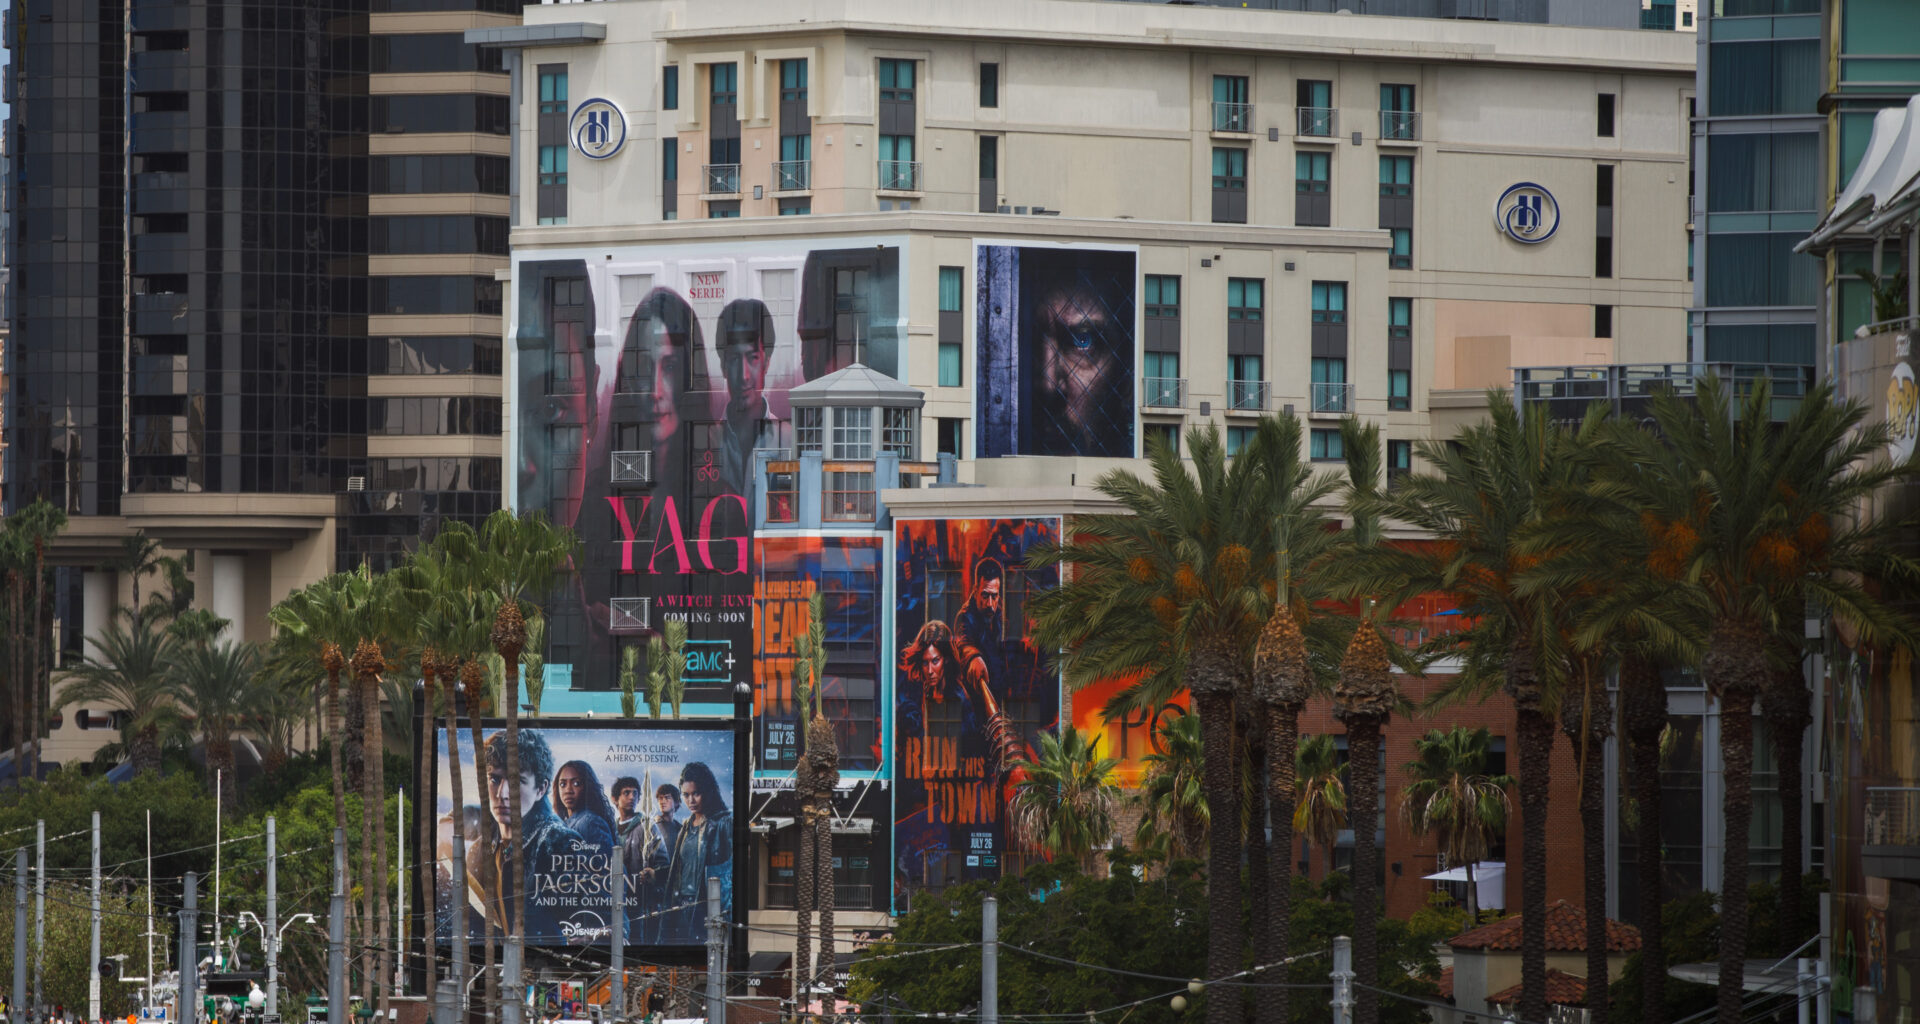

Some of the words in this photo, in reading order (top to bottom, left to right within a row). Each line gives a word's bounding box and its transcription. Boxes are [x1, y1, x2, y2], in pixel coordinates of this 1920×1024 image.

[697, 274, 720, 286] NEW
[656, 595, 664, 608] A
[667, 594, 713, 608] WITCH
[663, 612, 712, 623] COMING
[768, 731, 784, 745] JULY
[785, 731, 795, 745] 26
[608, 745, 614, 753] A
[616, 744, 648, 753] TITAN'S
[649, 745, 678, 753] CURSE.
[605, 754, 612, 762] A
[613, 754, 643, 763] HERO'S
[645, 754, 680, 763] DESTINY.
[905, 736, 957, 779] RUN
[924, 782, 997, 825] TOWN
[970, 838, 984, 849] JULY
[984, 838, 993, 849] 26
[535, 897, 557, 906] AND
[560, 897, 578, 906] THE
